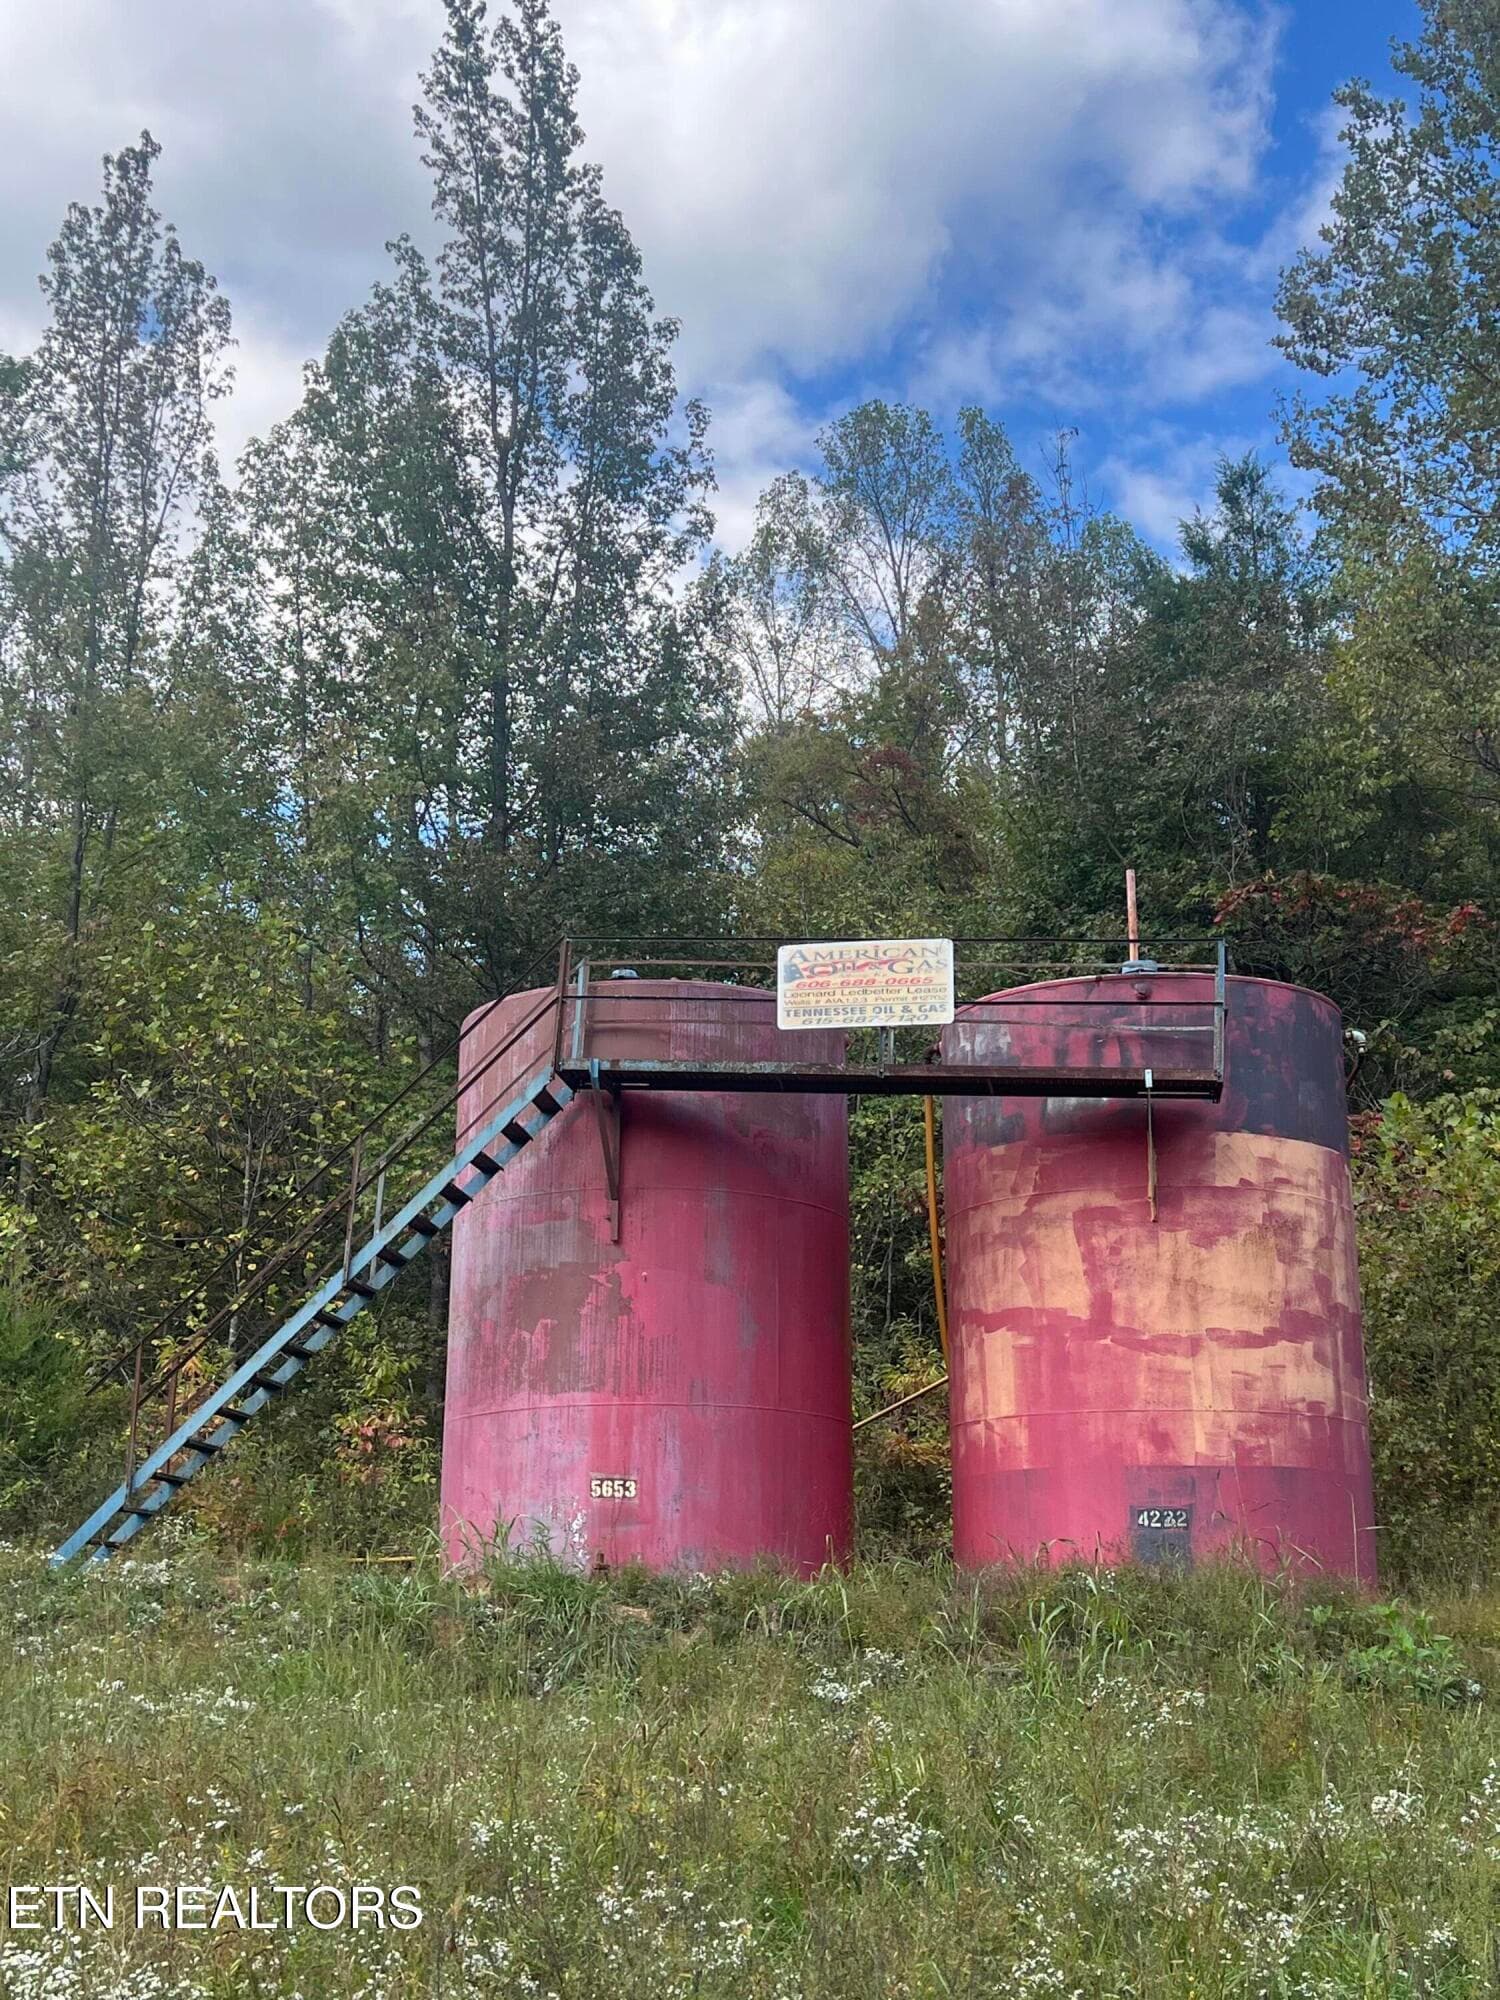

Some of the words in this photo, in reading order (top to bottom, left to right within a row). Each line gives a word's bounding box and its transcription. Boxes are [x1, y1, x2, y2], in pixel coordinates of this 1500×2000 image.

[788, 945, 939, 962] AMERICAN
[888, 959, 948, 974] GAS
[796, 977, 934, 989] 606-688-0665
[784, 990, 836, 998] Leonard
[841, 986, 902, 997] Ledbetter
[907, 986, 947, 995] Lease
[785, 1006, 867, 1018] TENNESSEE
[873, 1005, 895, 1014] OIL
[901, 1005, 912, 1013] &
[918, 1004, 947, 1013] GAS
[590, 1479, 637, 1498] 5653
